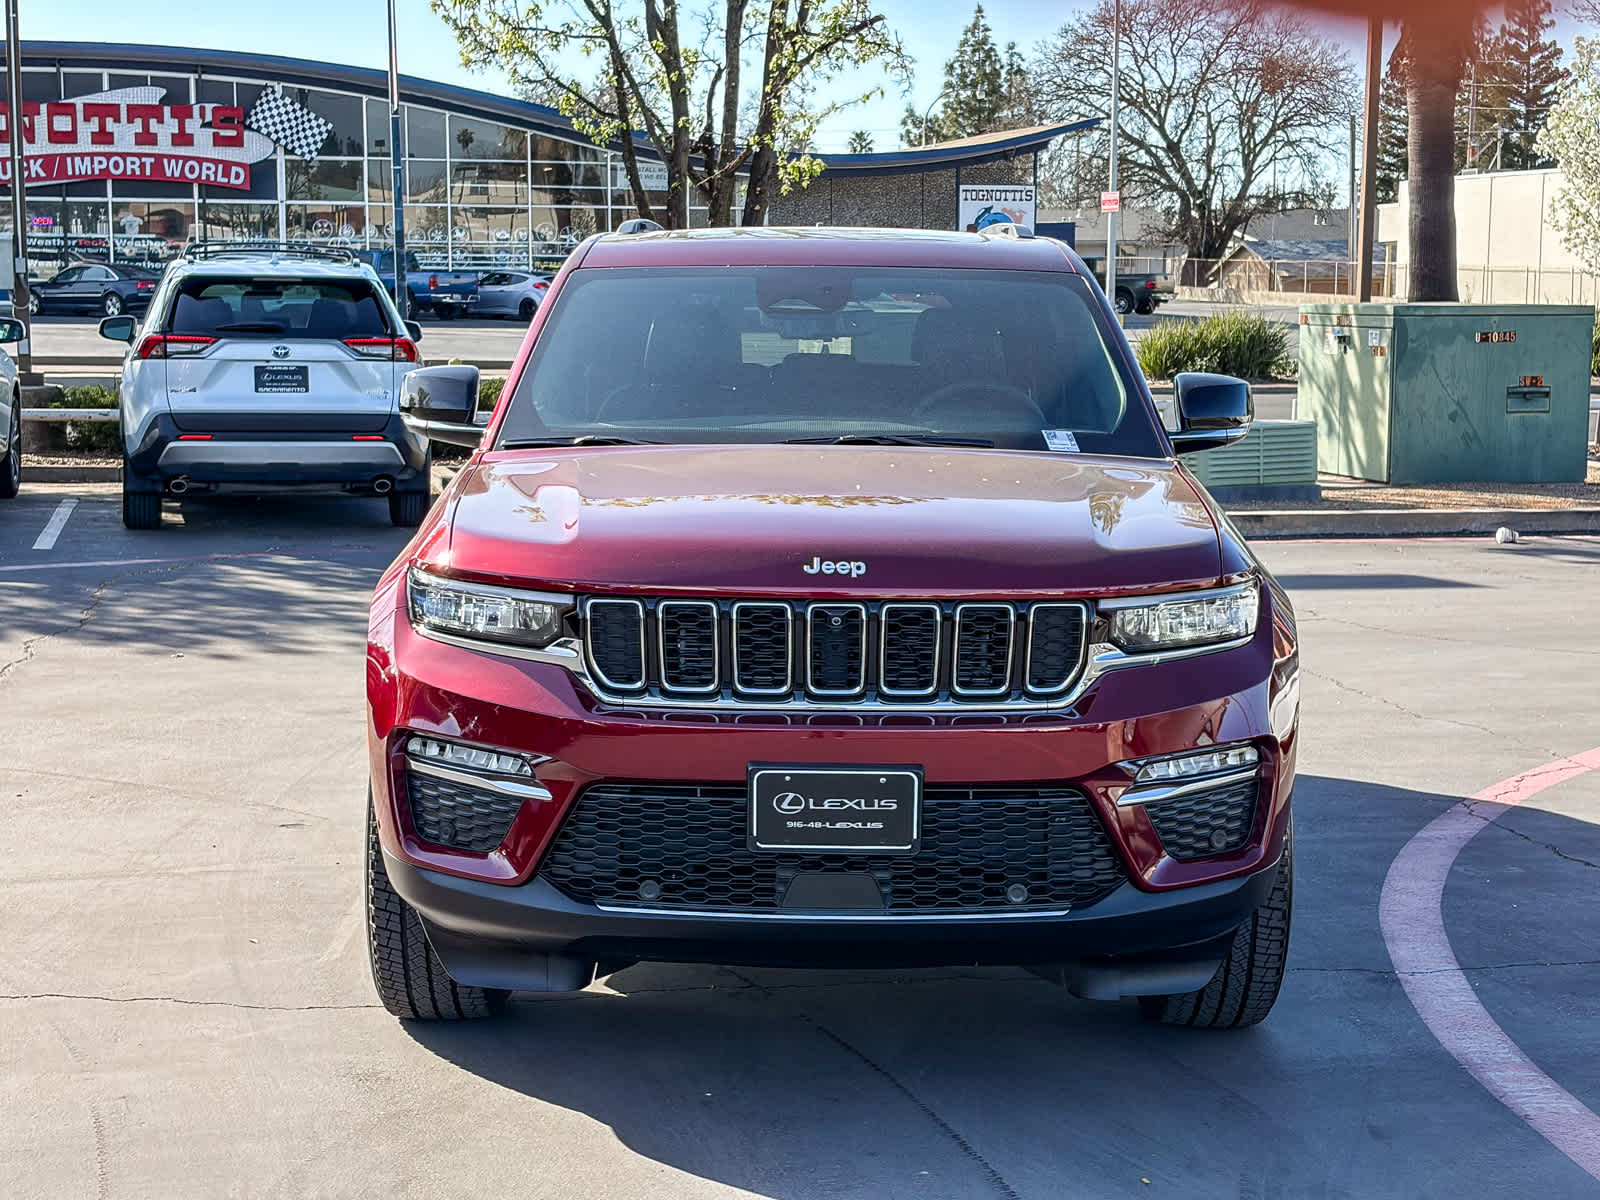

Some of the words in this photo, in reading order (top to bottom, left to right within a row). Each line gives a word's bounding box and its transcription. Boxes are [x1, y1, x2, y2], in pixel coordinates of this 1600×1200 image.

[66, 156, 155, 177] IMPORT
[163, 158, 246, 185] WORLD
[962, 188, 1033, 202] TOGNOTTI'S
[803, 557, 866, 578] Jeep
[809, 798, 898, 810] LEXUS
